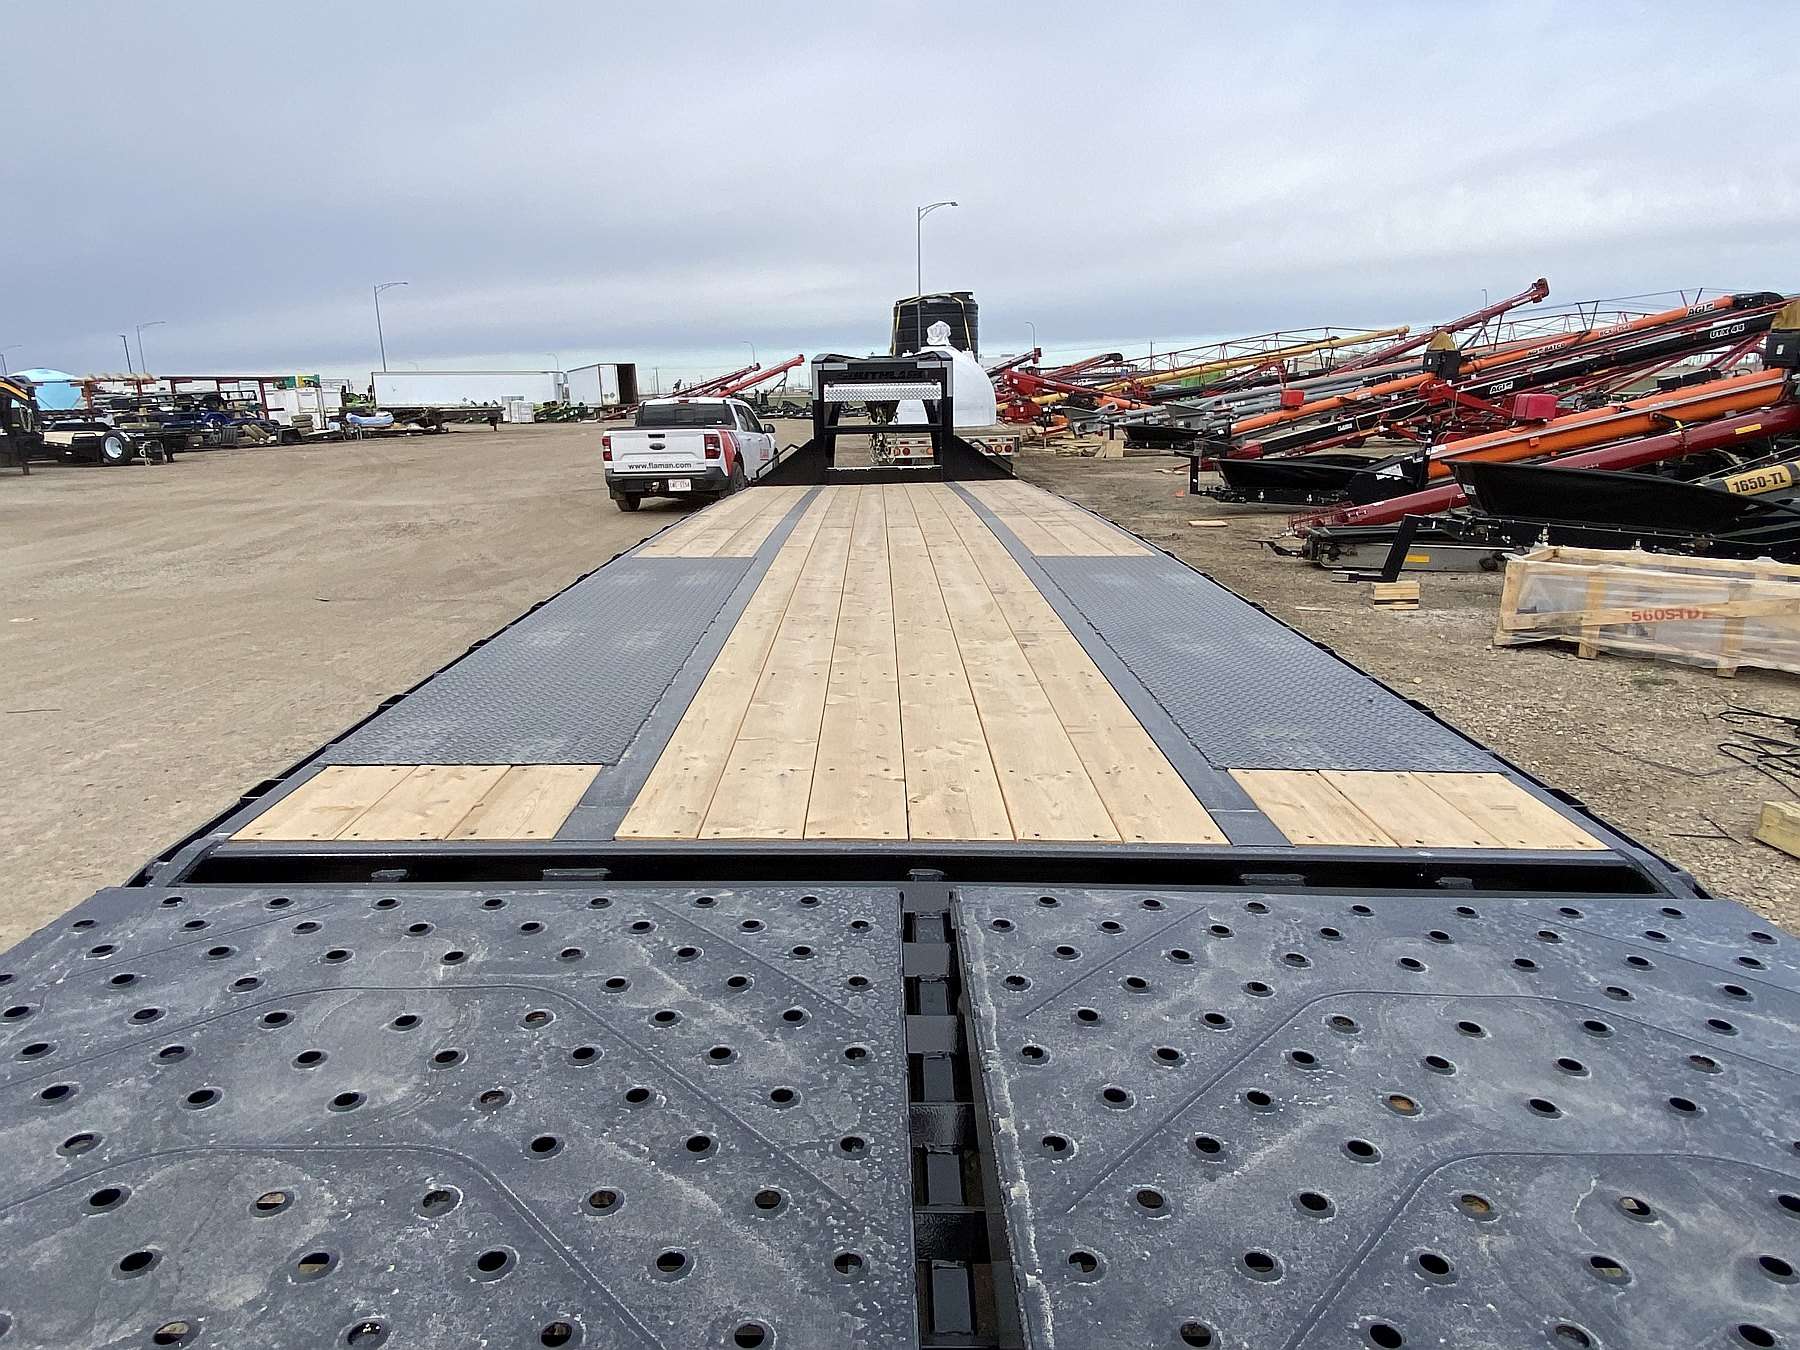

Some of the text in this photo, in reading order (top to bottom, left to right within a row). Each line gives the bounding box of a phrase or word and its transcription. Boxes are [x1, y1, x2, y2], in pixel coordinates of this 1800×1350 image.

[1709, 326, 1730, 339] UTX
[1489, 382, 1506, 395] AGI
[1732, 472, 1787, 493] 1650-TL
